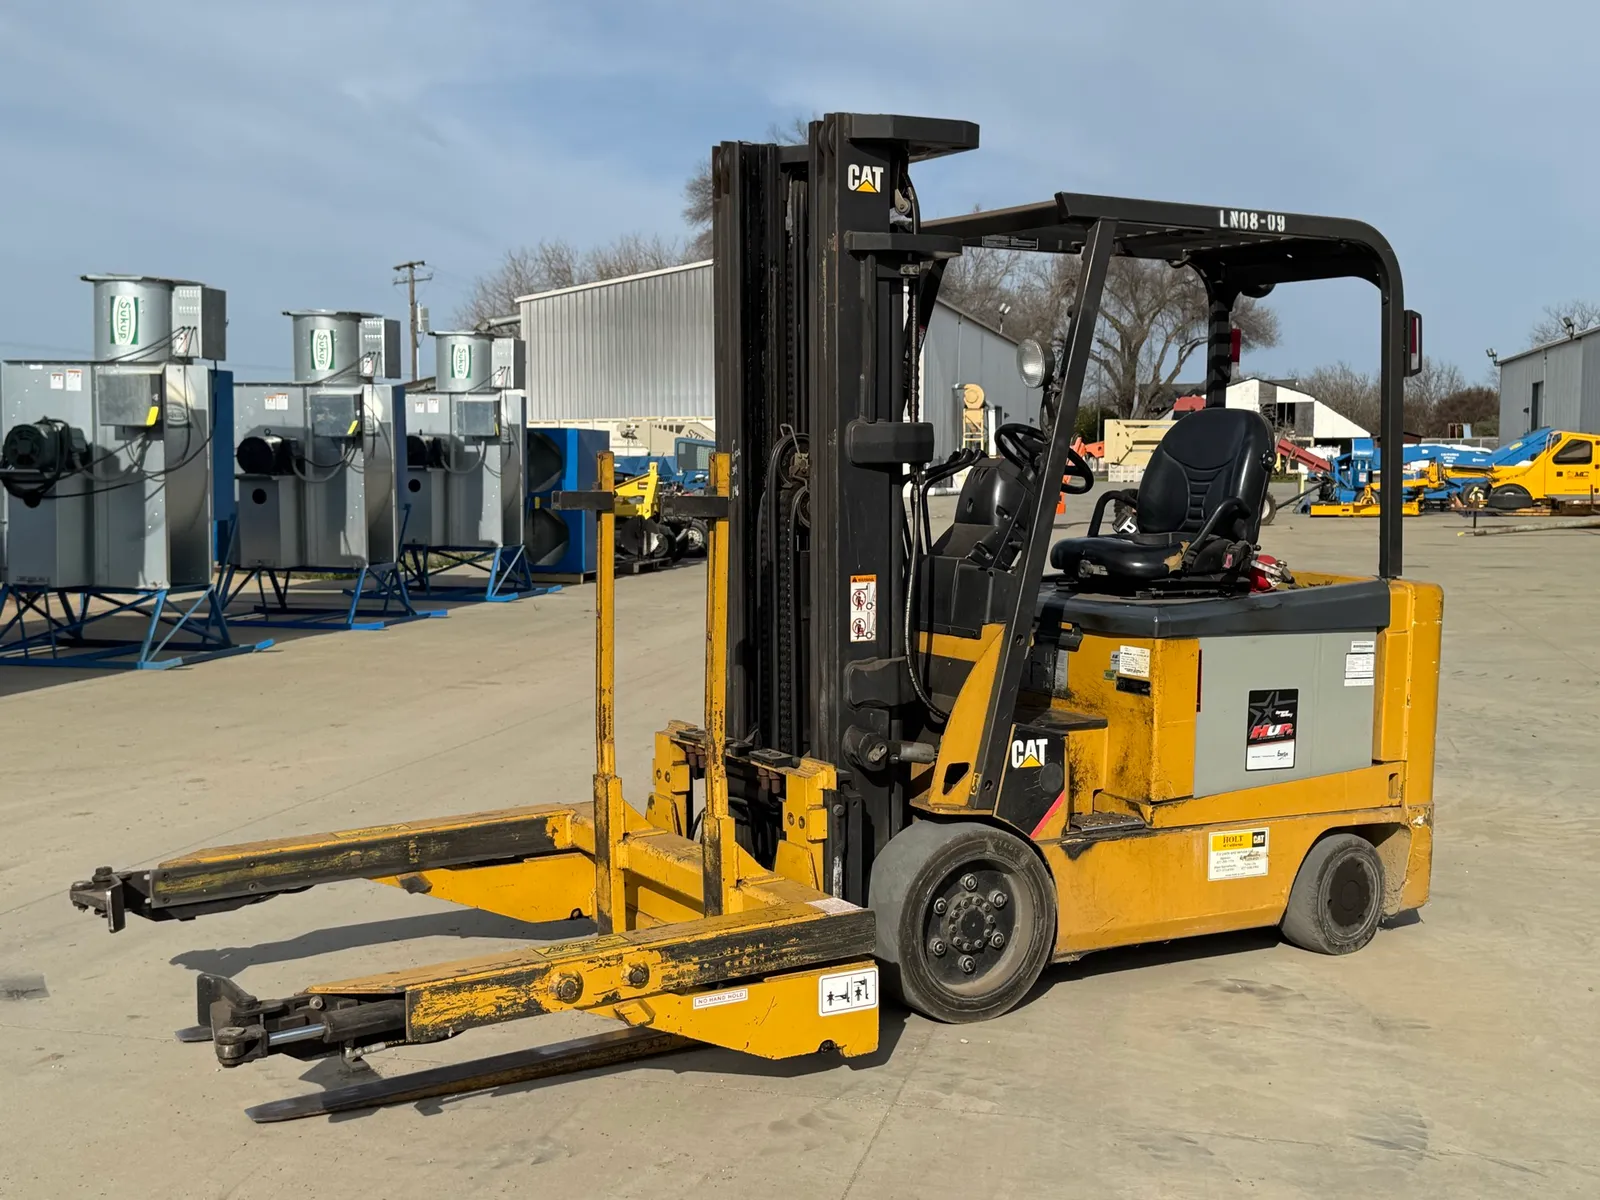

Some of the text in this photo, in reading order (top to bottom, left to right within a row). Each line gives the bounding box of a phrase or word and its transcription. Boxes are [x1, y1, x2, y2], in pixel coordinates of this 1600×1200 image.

[848, 164, 884, 193] CAT
[118, 301, 132, 339] Sukup
[1011, 738, 1048, 769] CAT
[1222, 835, 1244, 844] HOLT
[1253, 834, 1265, 844] CAT
[710, 995, 726, 1003] HAND
[728, 992, 744, 1000] HOLD
